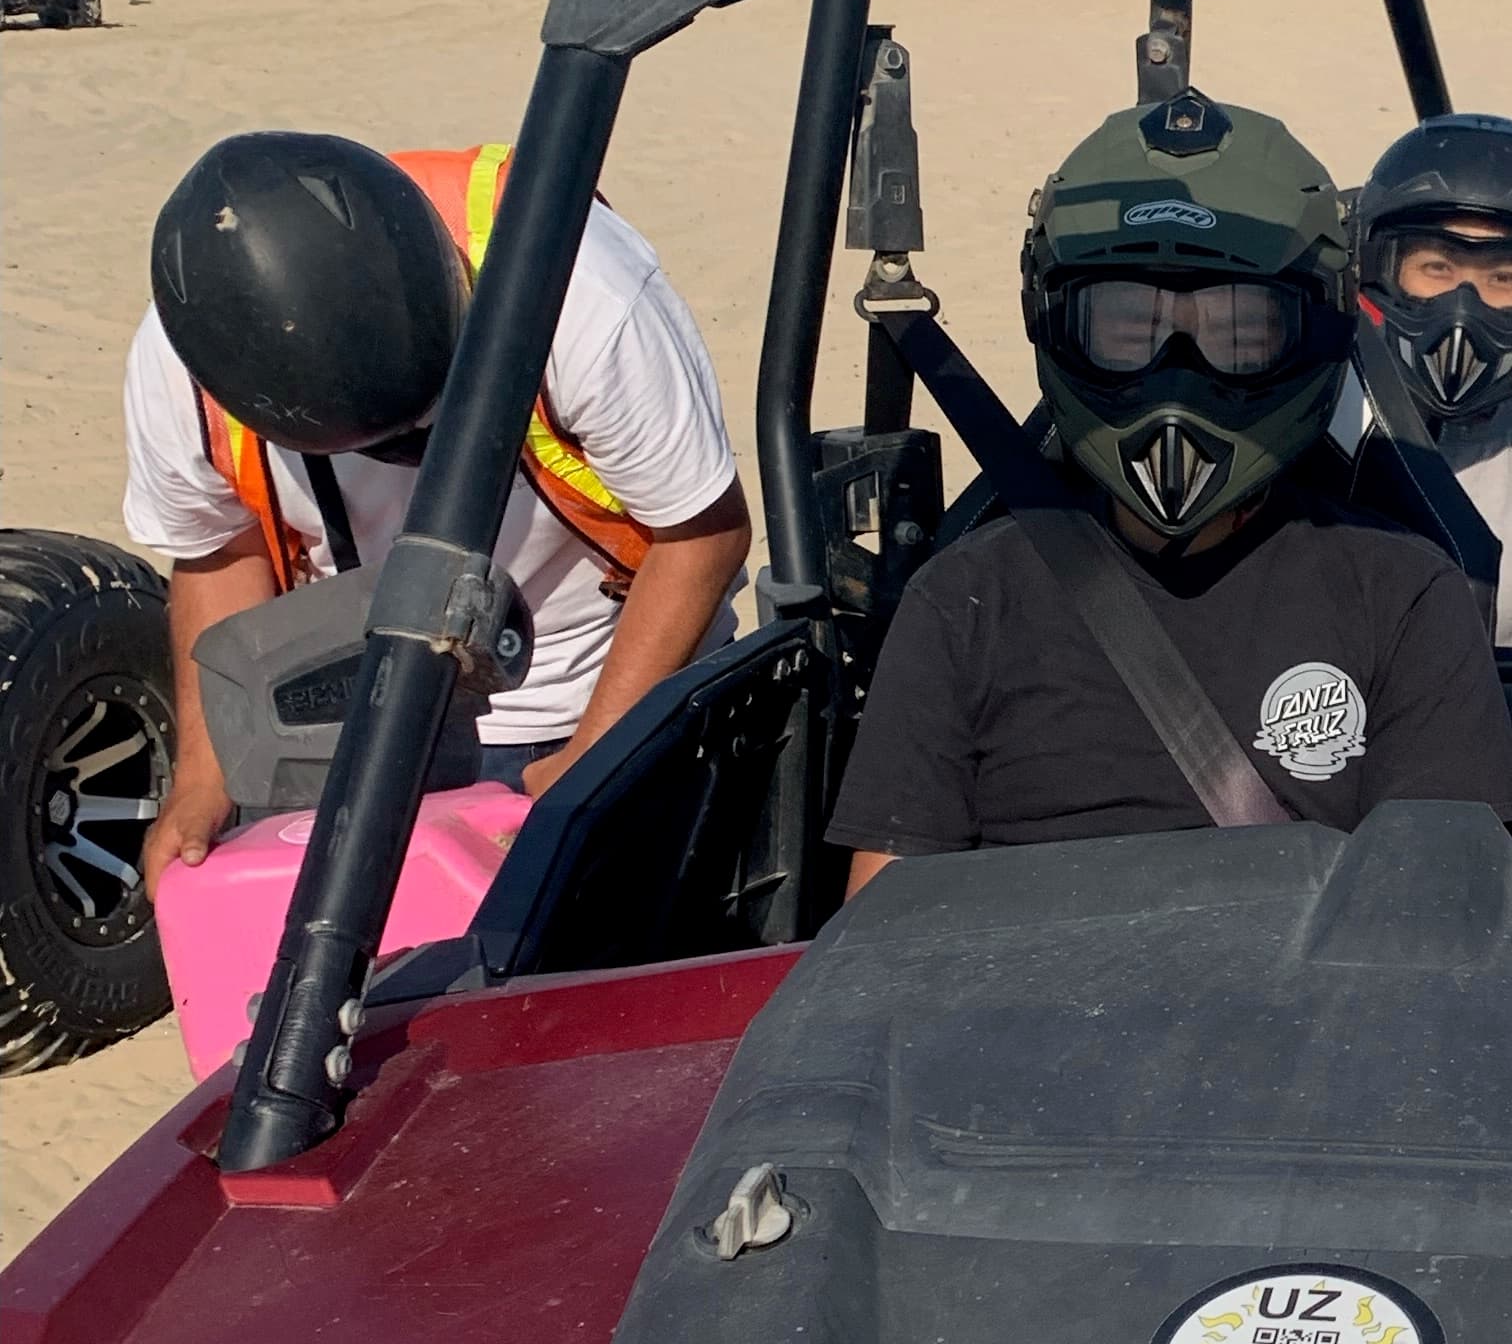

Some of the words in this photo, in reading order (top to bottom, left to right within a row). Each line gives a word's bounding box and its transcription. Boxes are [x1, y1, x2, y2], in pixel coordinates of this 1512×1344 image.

[1264, 679, 1348, 725] SANTA
[1276, 709, 1347, 752] CRUZ
[1258, 1286, 1342, 1322] UZ
